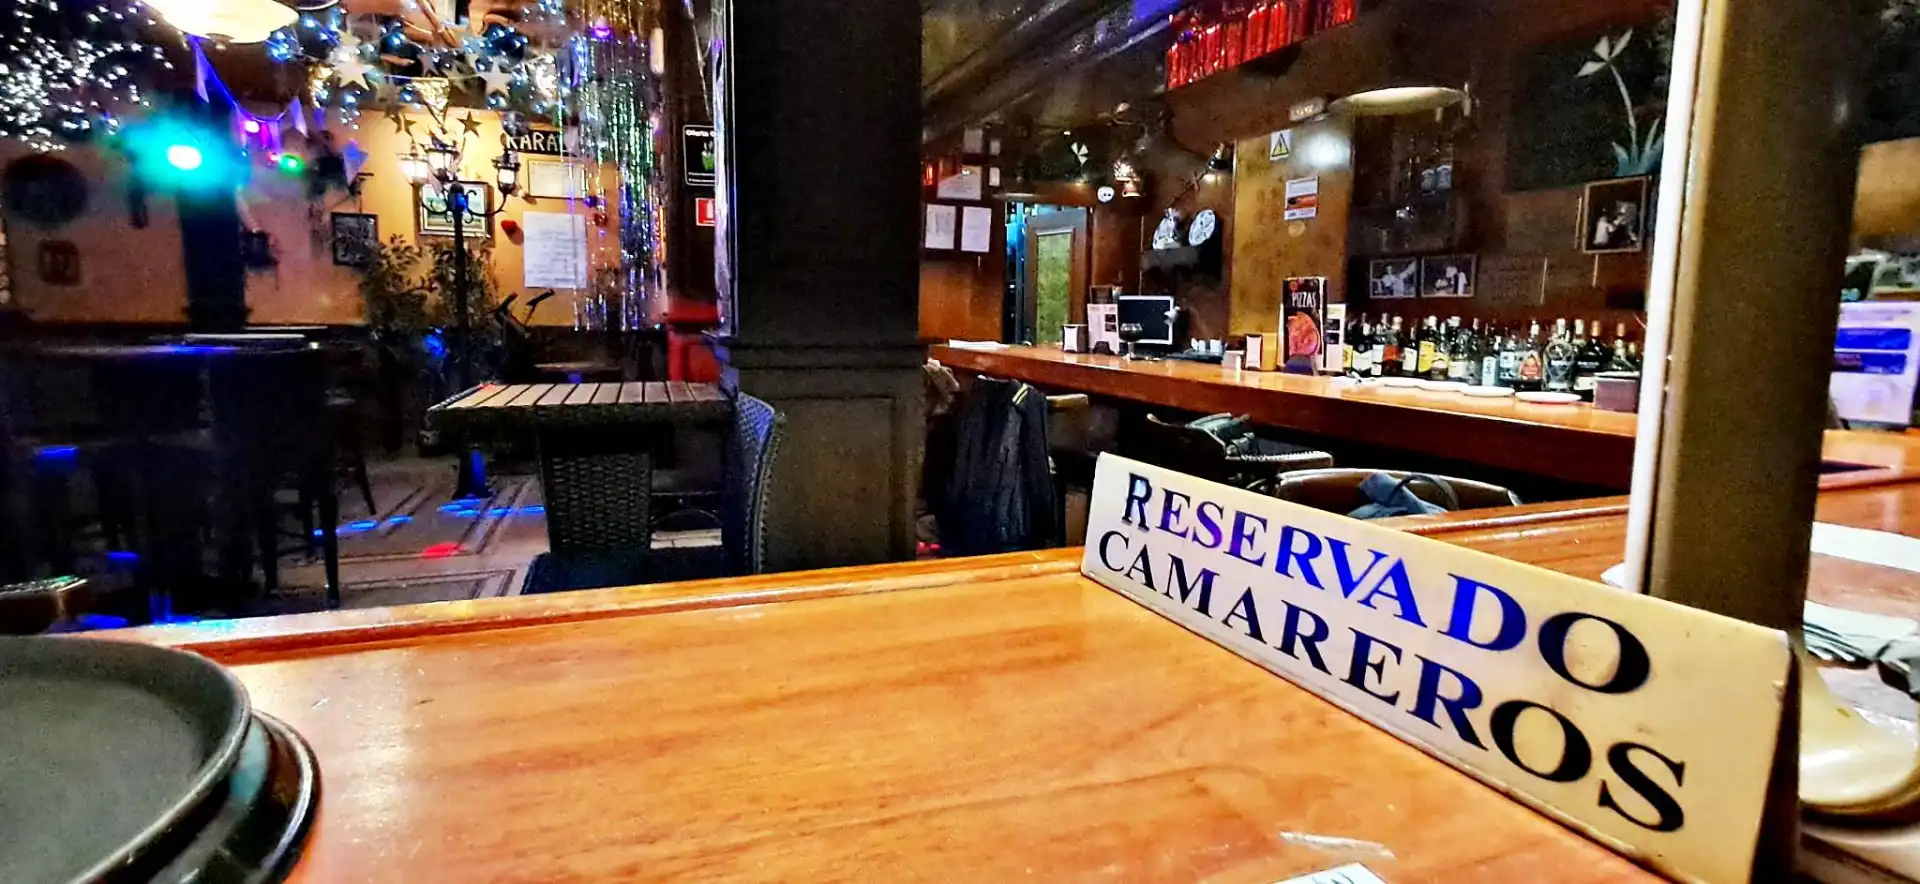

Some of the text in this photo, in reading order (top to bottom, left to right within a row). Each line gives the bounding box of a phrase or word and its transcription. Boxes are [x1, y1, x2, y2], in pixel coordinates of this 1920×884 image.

[1291, 291, 1317, 309] PIZZAS
[1098, 530, 1685, 833] CAMAREROS
[1121, 472, 1651, 694] RESERVADO
